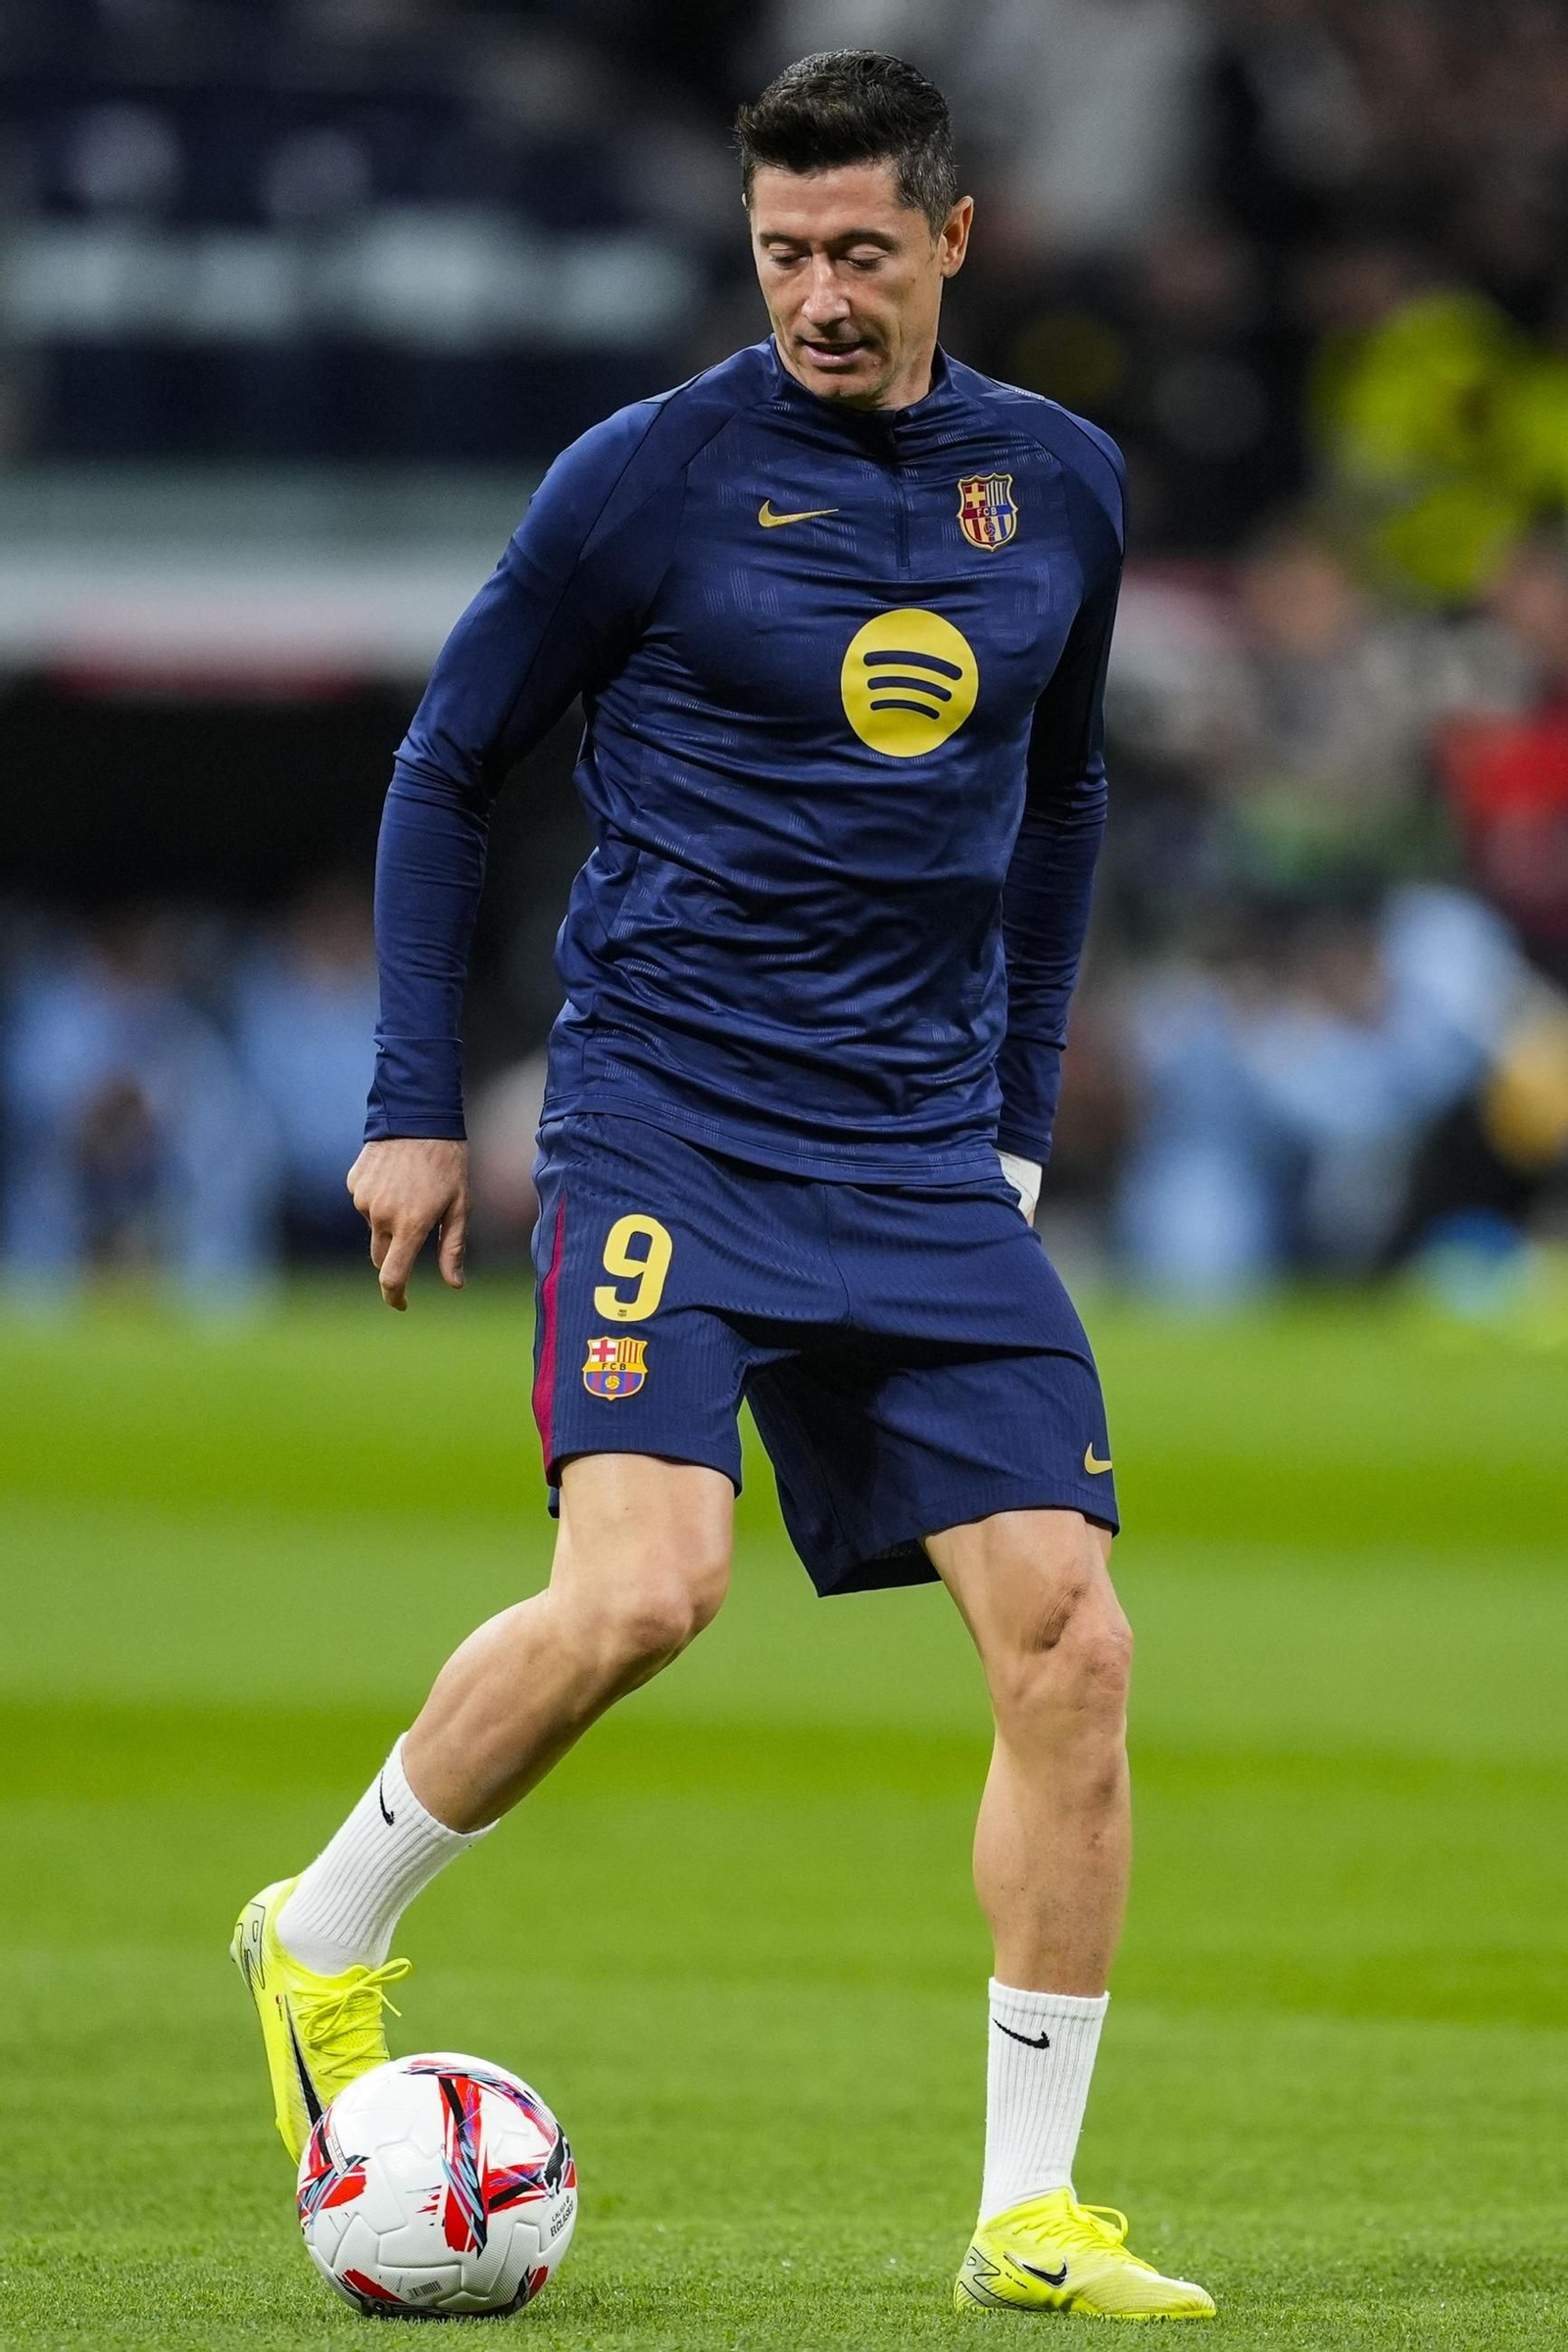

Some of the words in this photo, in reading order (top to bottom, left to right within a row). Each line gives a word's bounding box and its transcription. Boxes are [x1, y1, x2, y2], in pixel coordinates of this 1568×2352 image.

[976, 507, 998, 517] FCB
[594, 1213, 673, 1322] 9
[601, 1362, 627, 1371] FCB
